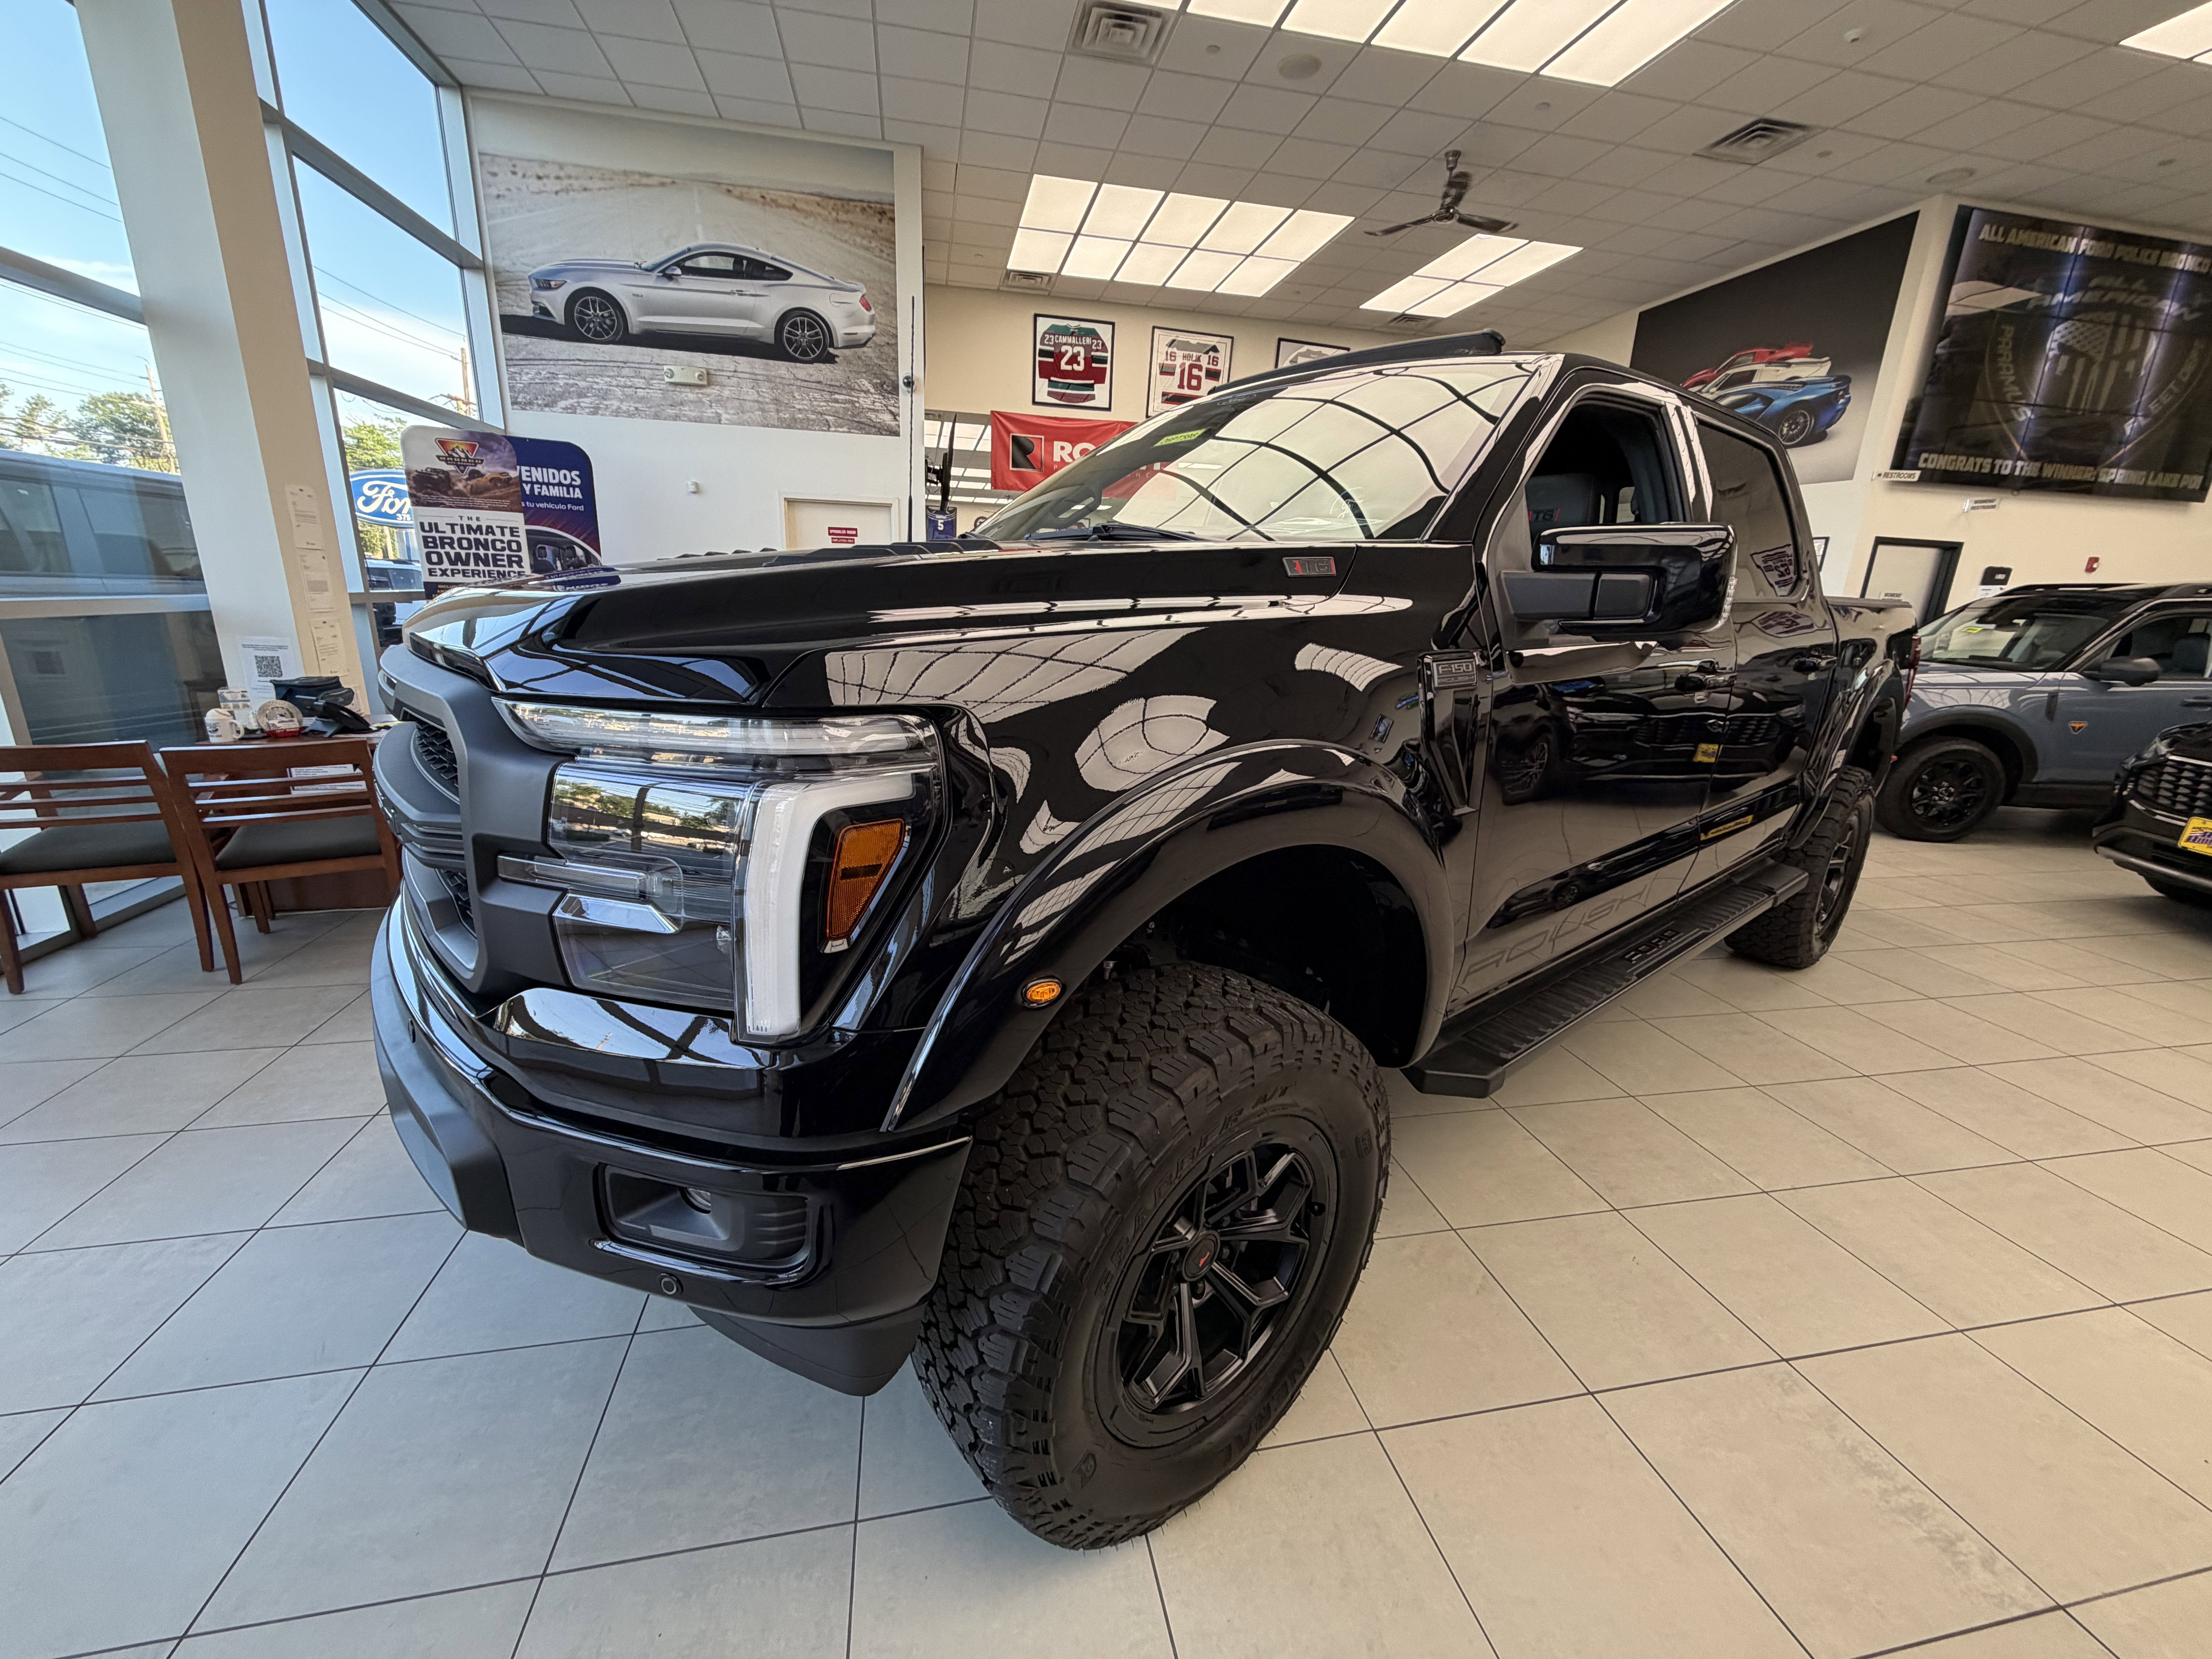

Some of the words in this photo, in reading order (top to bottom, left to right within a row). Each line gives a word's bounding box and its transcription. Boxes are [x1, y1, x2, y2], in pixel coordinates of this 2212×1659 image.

[1978, 223, 2004, 243] ALL
[2005, 227, 2078, 254] AMERICAN
[1044, 334, 1054, 345] 23
[1054, 335, 1092, 345] CAMMALLERI
[1092, 339, 1102, 350] 23
[1060, 345, 1085, 372] 23
[1165, 350, 1177, 362] 16
[1182, 352, 1202, 363] HOLIK
[1207, 355, 1219, 367] 16
[1177, 362, 1203, 391] 16
[1918, 452, 1991, 474] CONGRATS
[1993, 458, 2014, 475] TO
[2014, 460, 2040, 478] THE
[522, 483, 532, 495] Y
[533, 484, 583, 500] FAMILIA
[567, 503, 585, 512] Ford
[419, 521, 520, 538] ULTIMATE
[938, 519, 944, 531] 5
[422, 535, 522, 553] BRONCO
[425, 551, 525, 569] OWNER
[428, 567, 526, 579] EXPERIENCE
[1439, 663, 1472, 674] F-150
